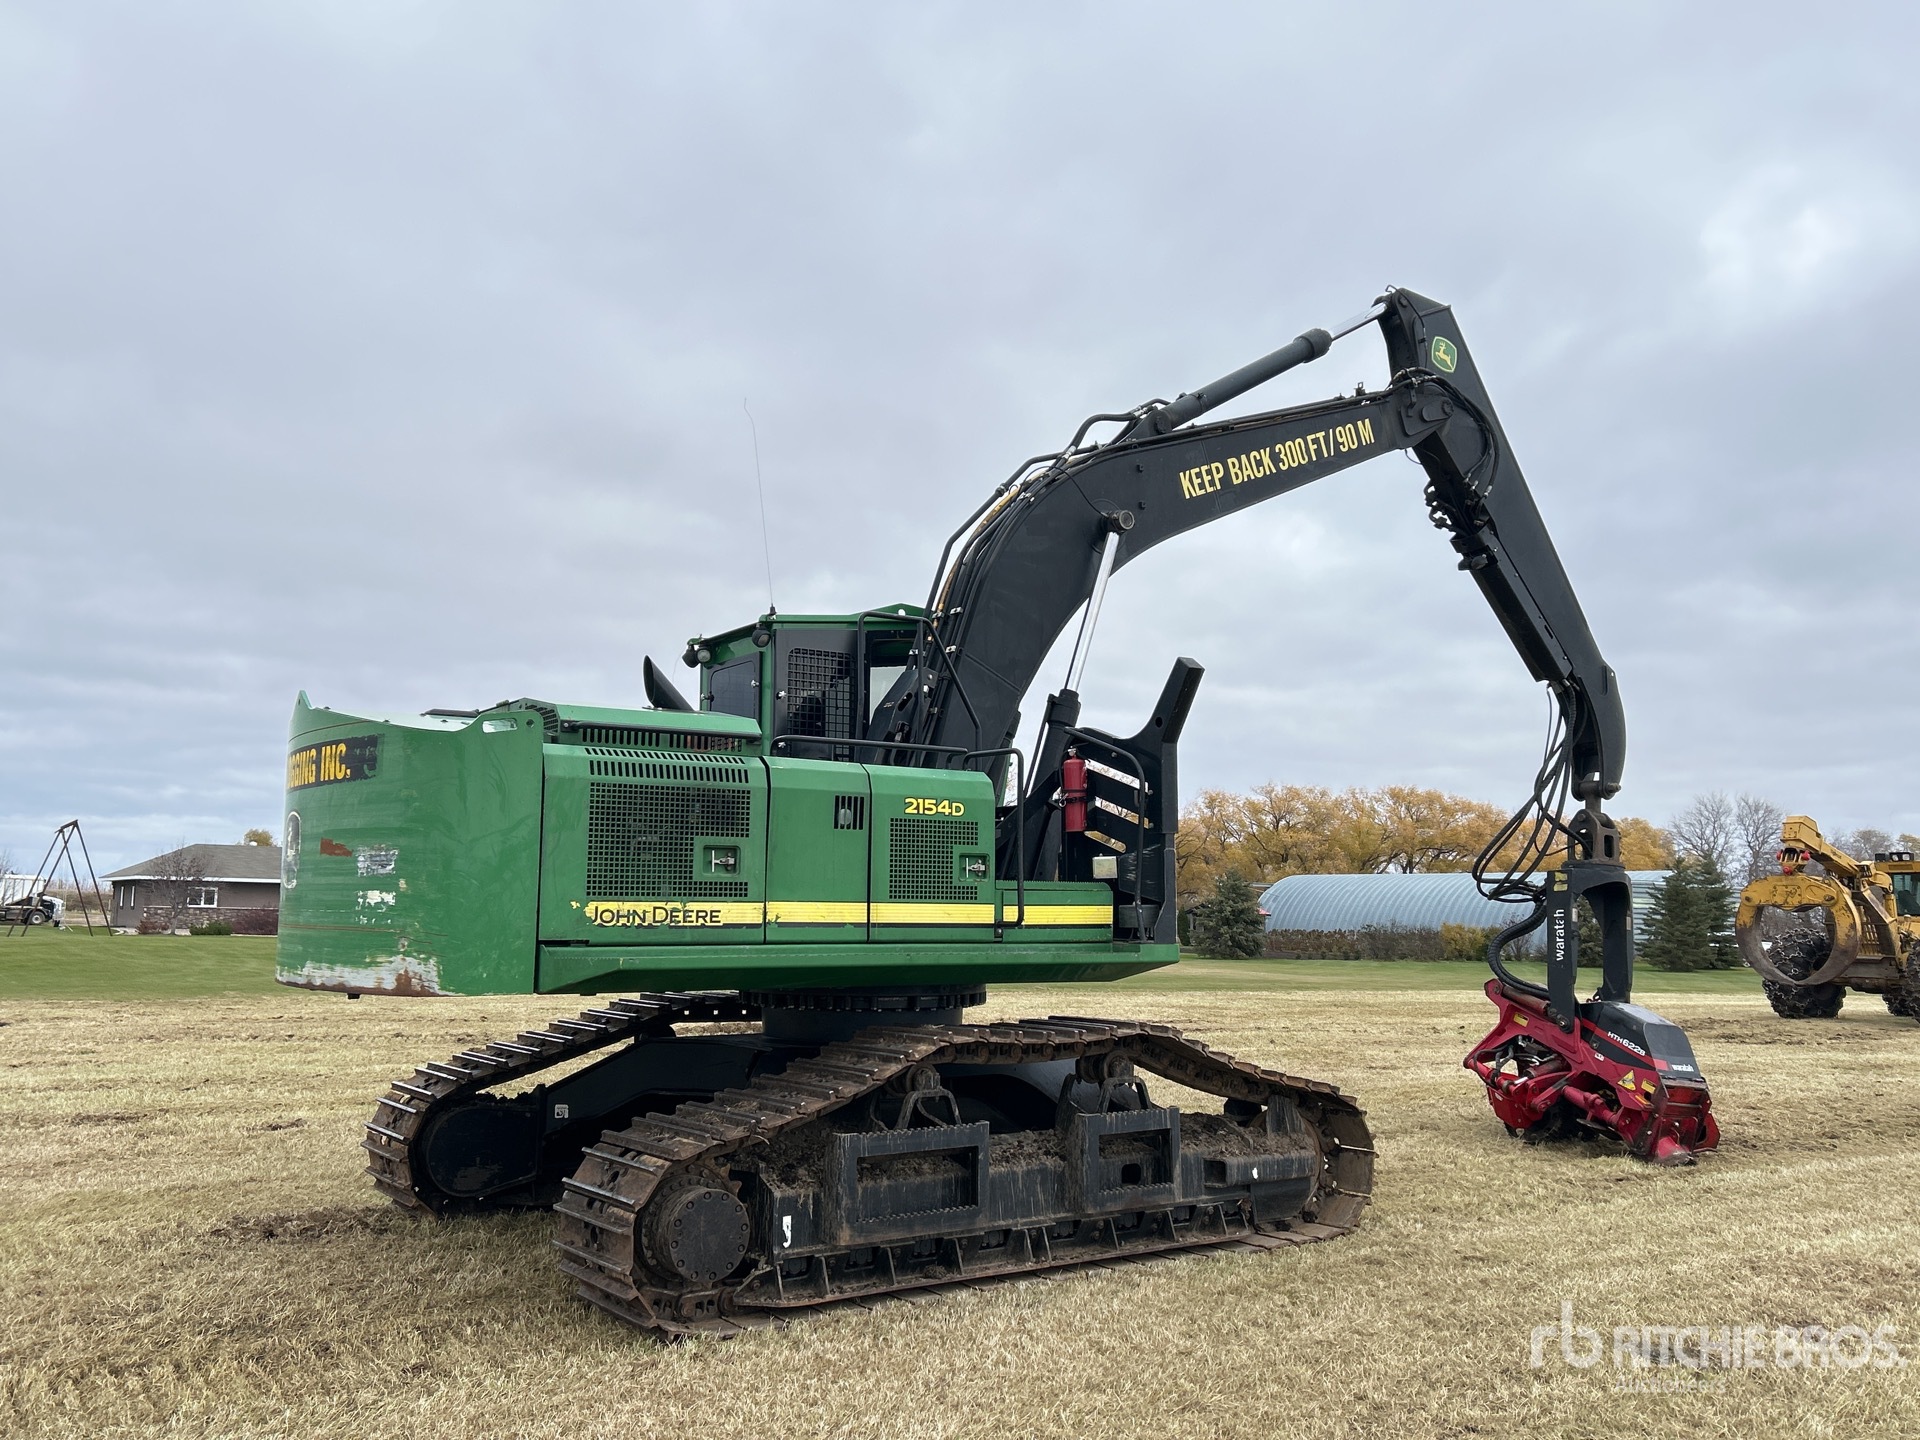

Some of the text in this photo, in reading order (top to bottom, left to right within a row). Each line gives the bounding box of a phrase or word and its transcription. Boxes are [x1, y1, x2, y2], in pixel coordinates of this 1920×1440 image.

[1179, 461, 1225, 500] KEEP
[1227, 446, 1277, 486] BACK
[1275, 437, 1309, 471] 300
[1359, 417, 1375, 446] M
[320, 742, 351, 782] INC.
[904, 796, 965, 817] 2154D
[591, 905, 722, 924] JOHN DEERE
[1553, 909, 1565, 962] waratah
